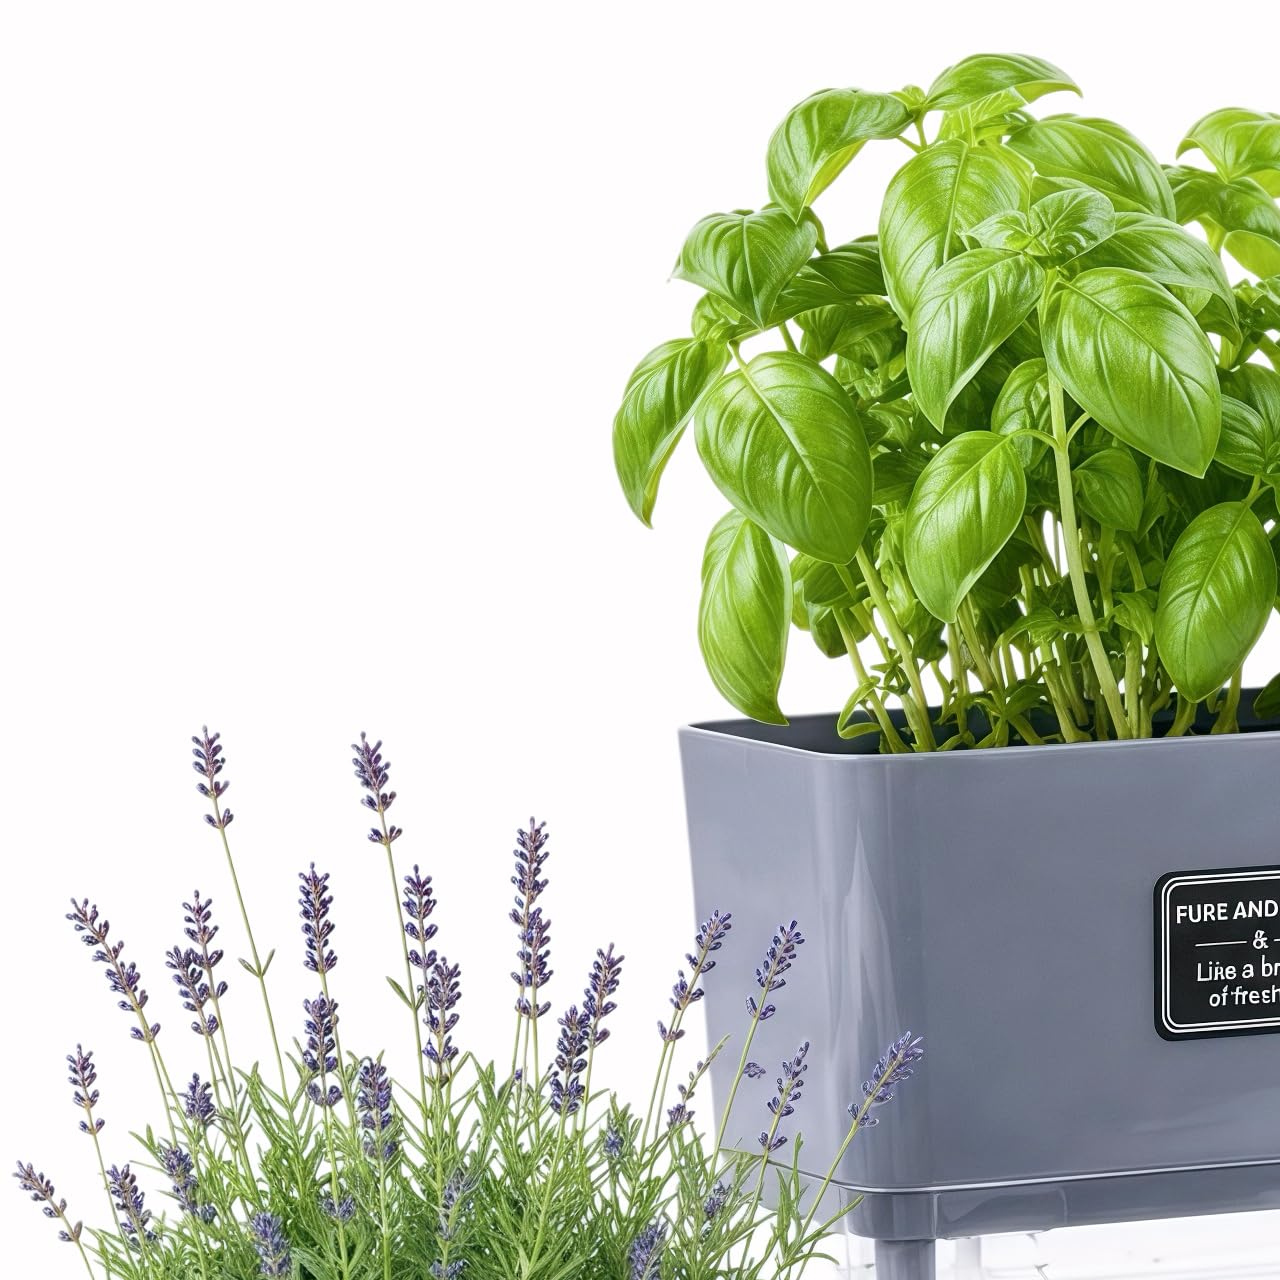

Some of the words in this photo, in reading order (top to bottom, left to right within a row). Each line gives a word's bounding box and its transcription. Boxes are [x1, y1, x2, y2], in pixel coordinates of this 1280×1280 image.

[1232, 899, 1279, 920] AND
[1241, 963, 1255, 979] a
[1209, 984, 1229, 1007] of
